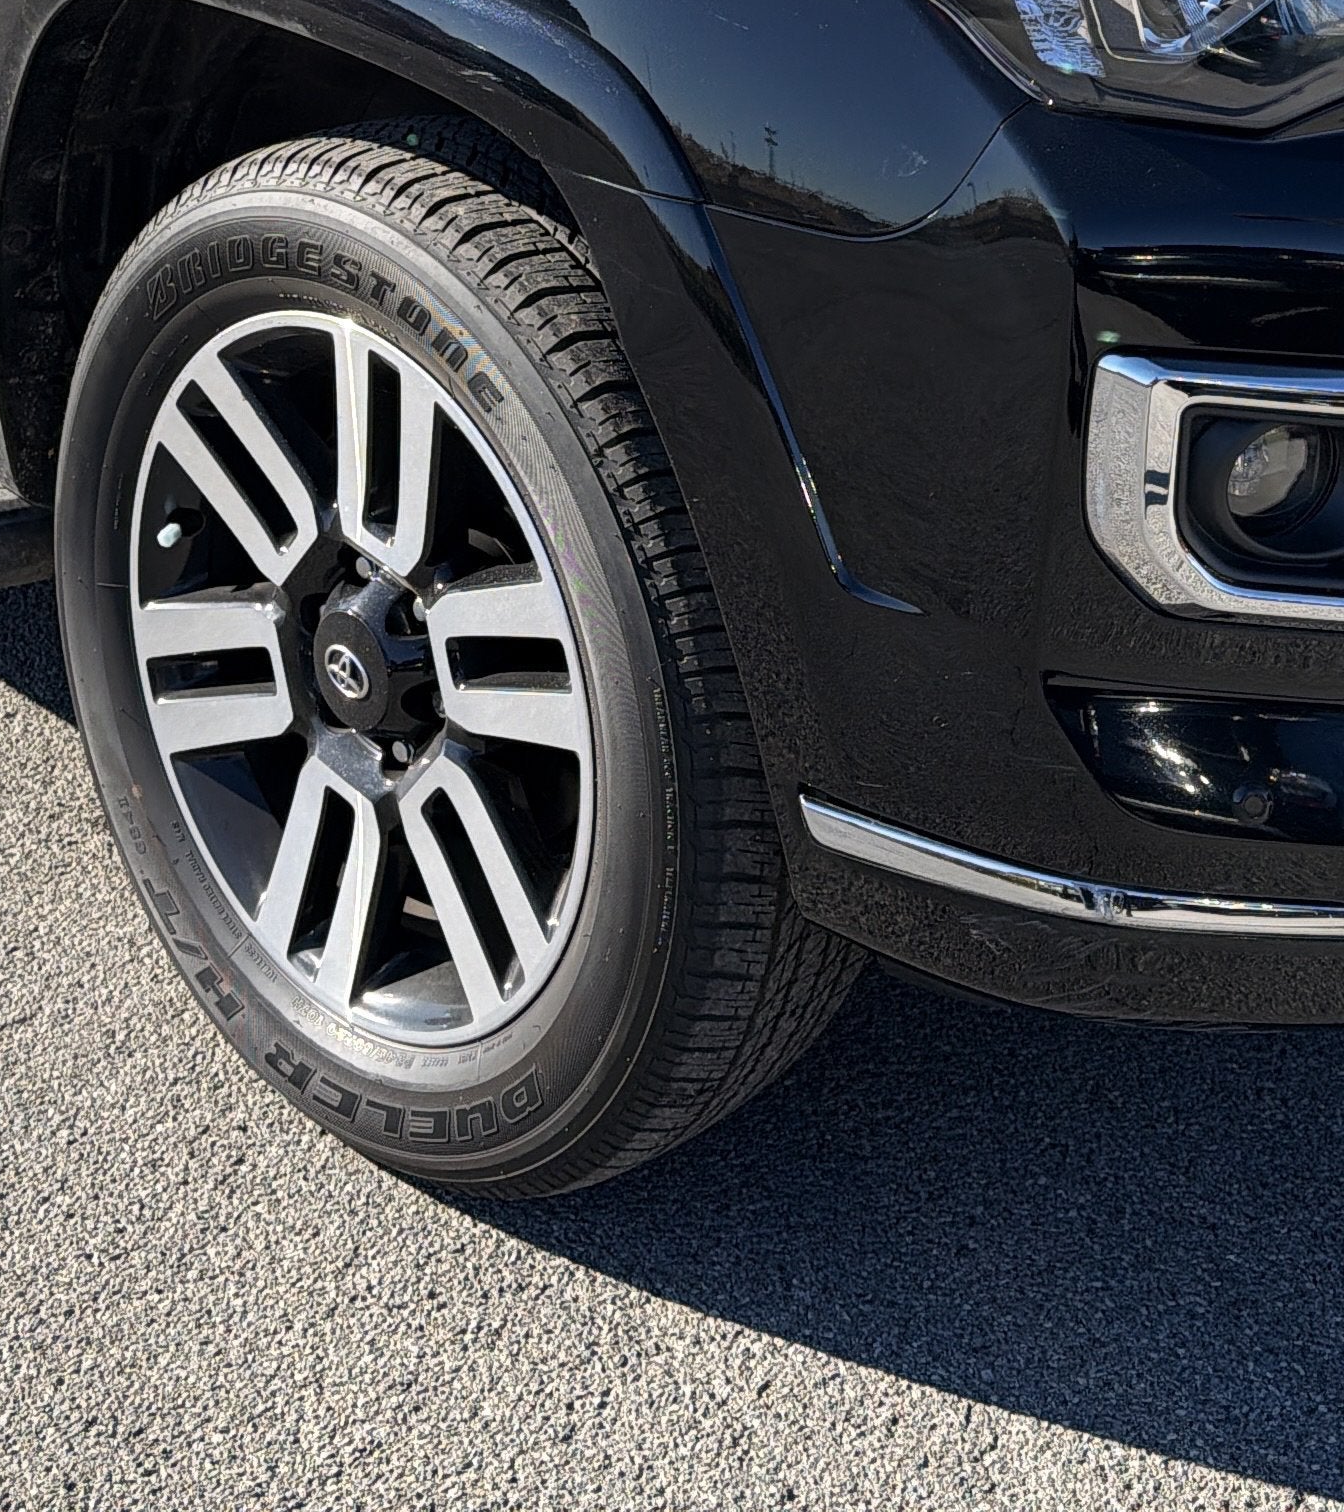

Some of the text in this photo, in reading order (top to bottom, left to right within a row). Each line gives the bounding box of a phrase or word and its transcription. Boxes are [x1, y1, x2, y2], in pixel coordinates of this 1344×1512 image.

[145, 233, 505, 414] BRIDGESTONE
[142, 878, 245, 1022] H/T
[264, 1041, 544, 1144] DUELER
